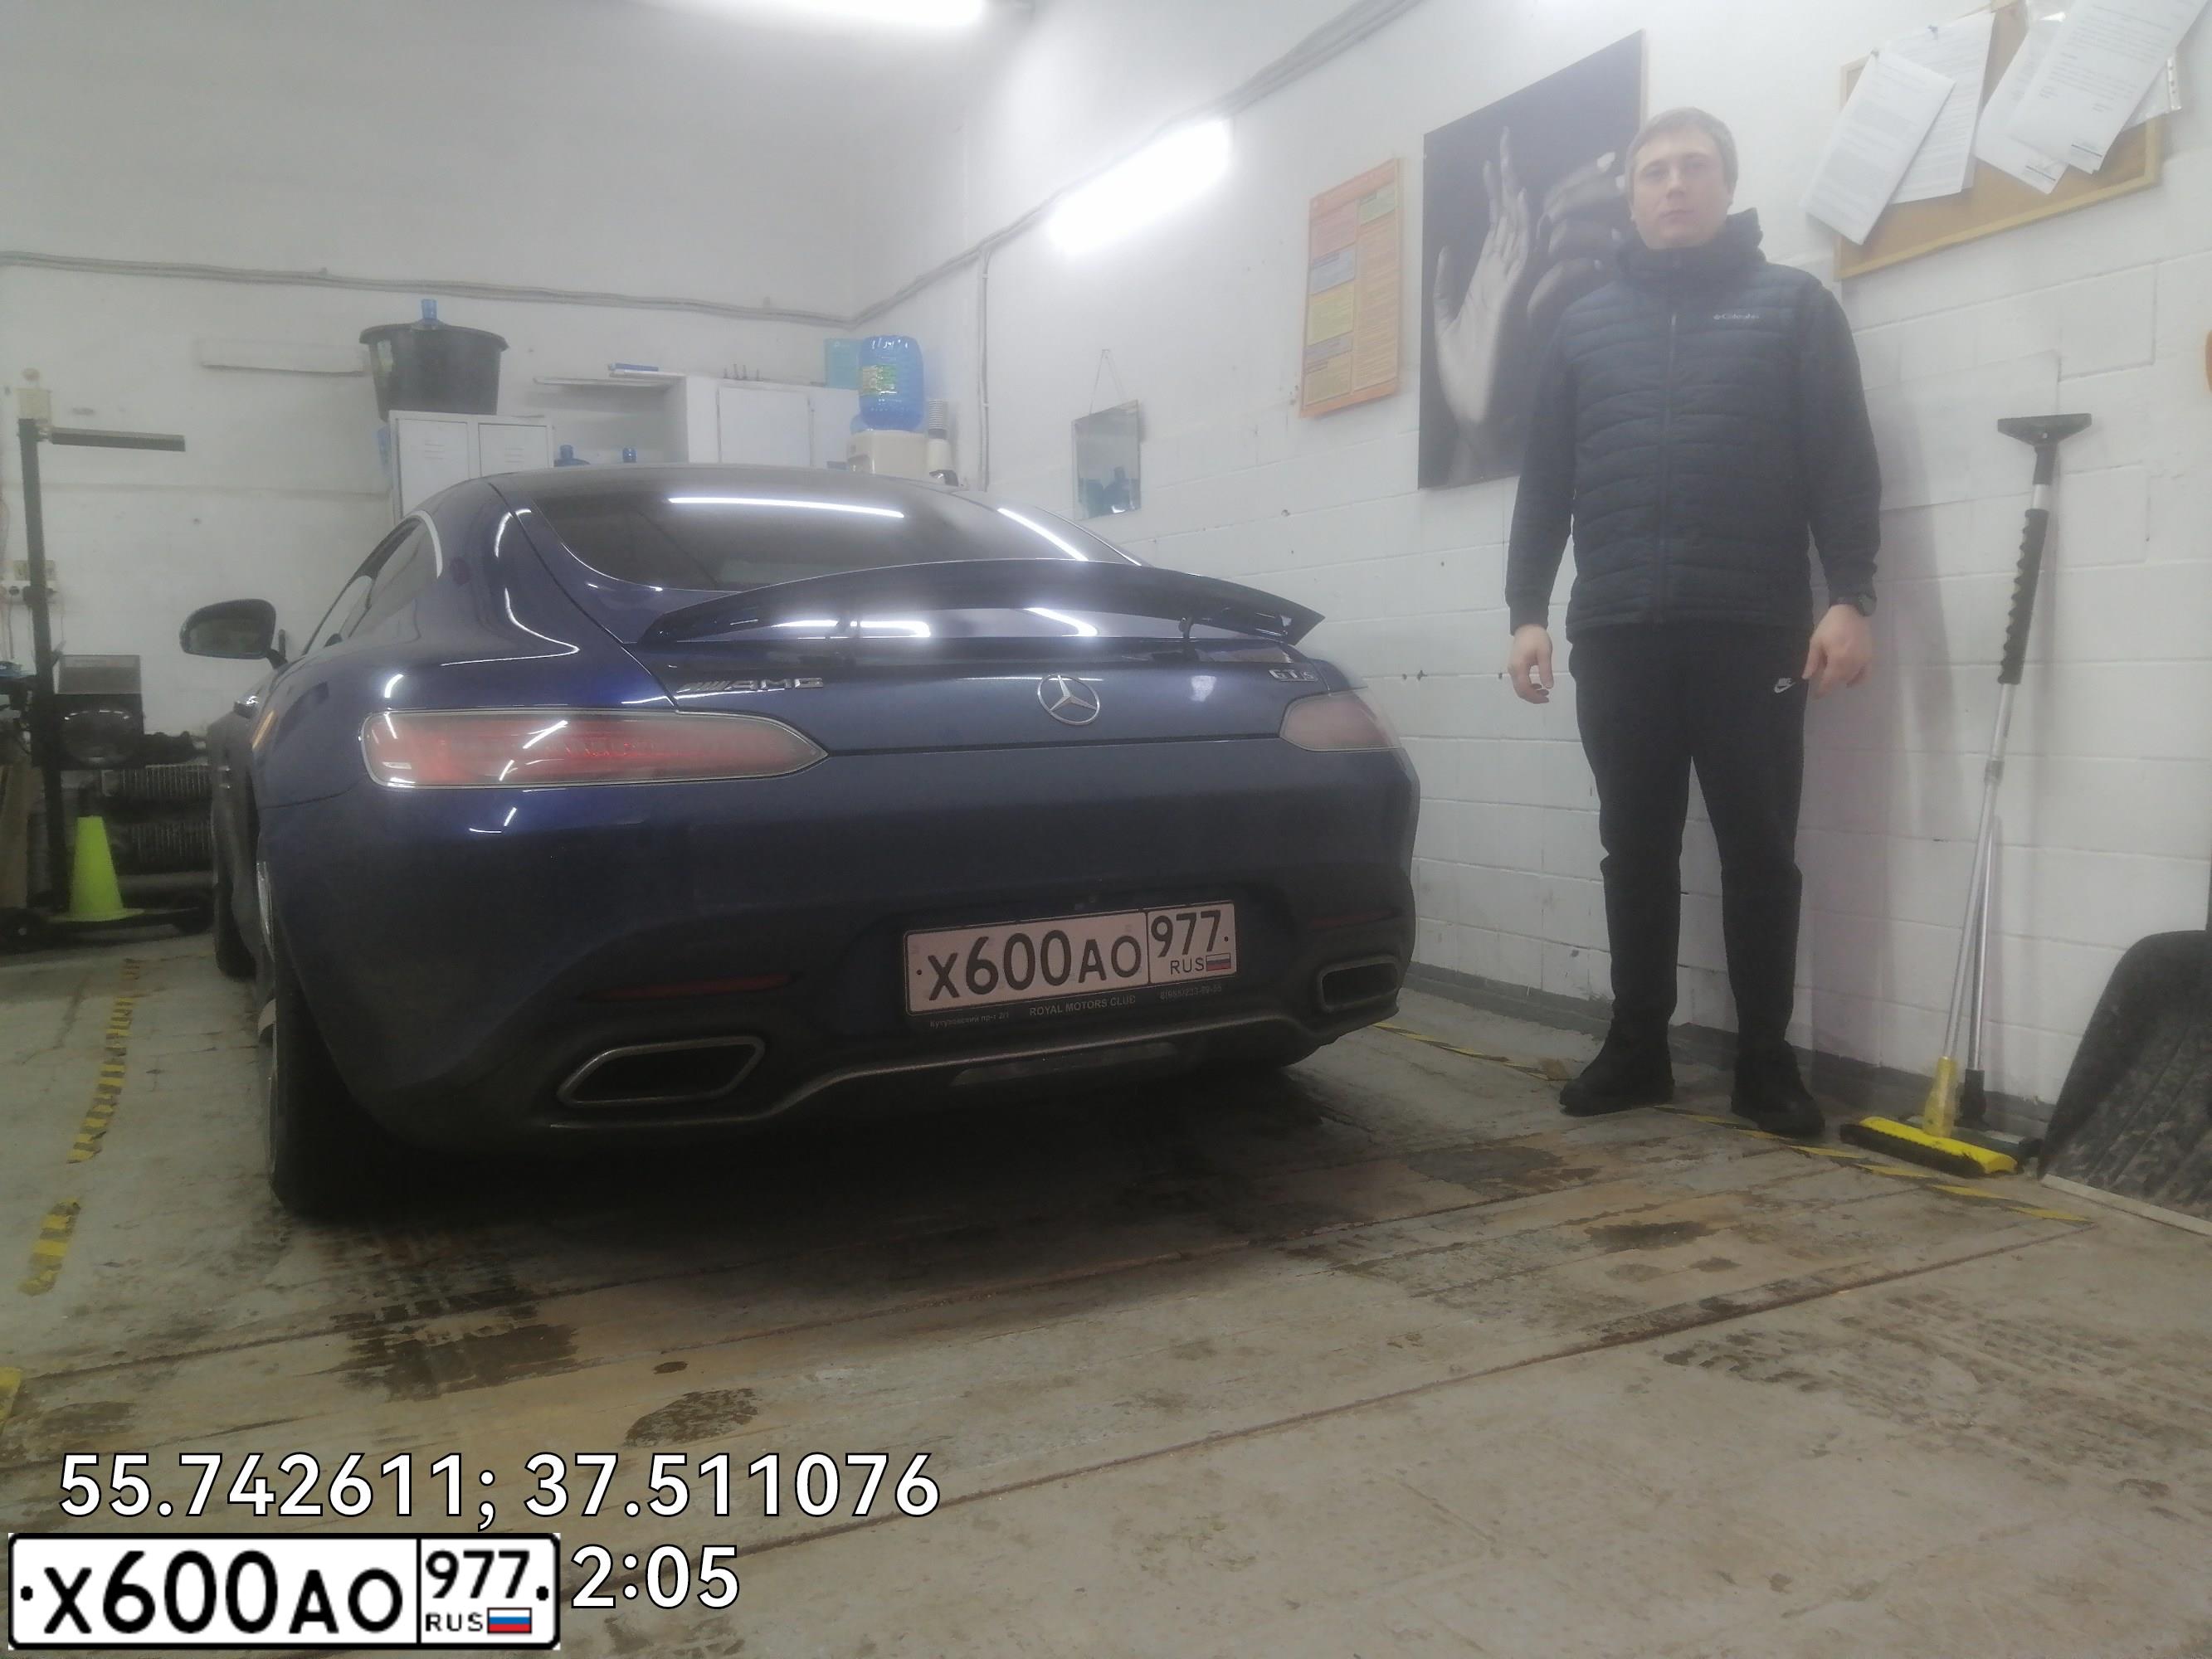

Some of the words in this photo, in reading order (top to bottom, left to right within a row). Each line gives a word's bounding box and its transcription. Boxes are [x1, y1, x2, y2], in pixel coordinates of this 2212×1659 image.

[1151, 909, 1222, 958] 977
[1170, 959, 1205, 975] RUS
[1029, 1006, 1063, 1017] ROYAL
[1065, 999, 1108, 1012] MOTORS
